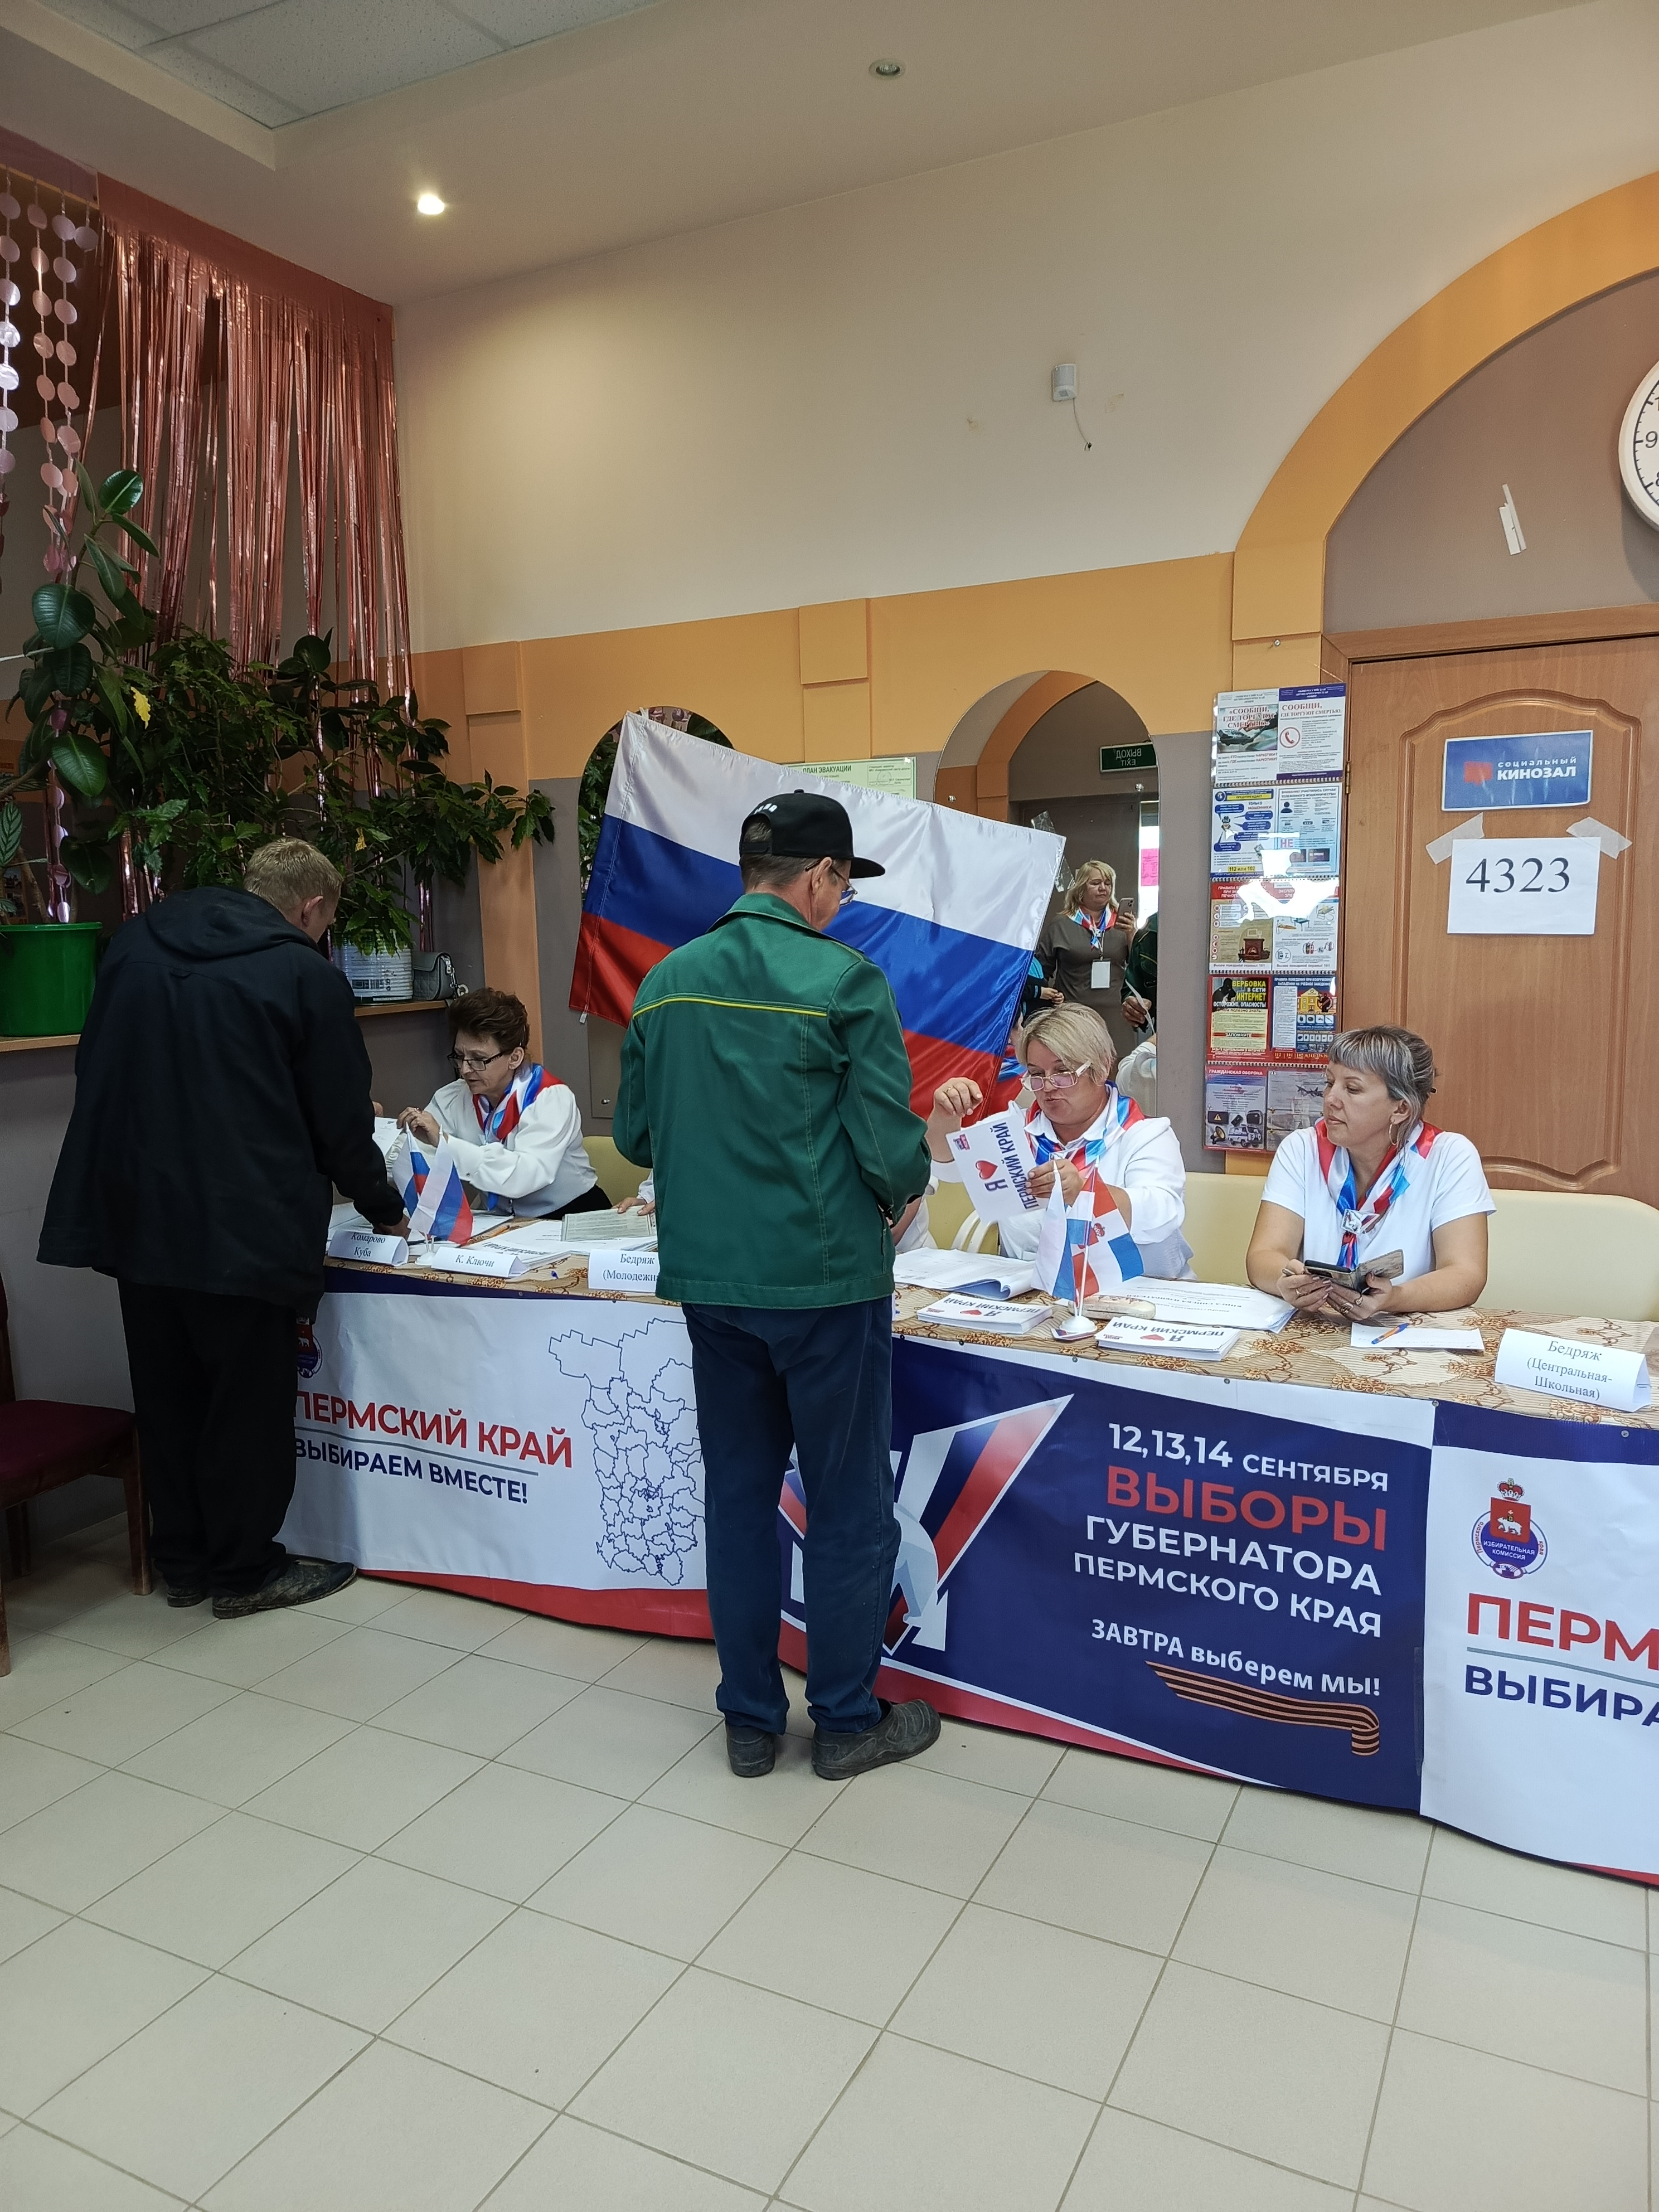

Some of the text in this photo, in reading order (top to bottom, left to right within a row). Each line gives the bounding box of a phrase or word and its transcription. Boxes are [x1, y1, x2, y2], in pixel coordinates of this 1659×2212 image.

[1646, 431, 1658, 448] 9
[1497, 756, 1577, 768] социальный
[1497, 766, 1577, 780] КИНОЗАЛ
[1280, 839, 1293, 848] НЕ
[1465, 857, 1570, 892] 4323
[1236, 993, 1266, 1001] ИНТЕРНЕТ
[989, 1122, 1039, 1210] ПЕРМСКИЙ КРАЙ
[984, 1178, 1008, 1192] Я
[351, 1232, 386, 1244] Комарово
[354, 1246, 371, 1258] Куба
[455, 1254, 495, 1267] К. Ключи
[620, 1253, 655, 1266] Бедряж
[943, 1297, 1041, 1313] ПЕРМСКИЙ КРАЙ
[1112, 1321, 1225, 1336] ПЕРМСКИЙ КРАЙ
[1548, 1341, 1602, 1361] Бедряж
[1527, 1357, 1613, 1382] (Центральная-
[1535, 1375, 1600, 1400] Школьная)
[297, 1391, 572, 1468] ПЕРМСКИЙ КРАЙ
[1109, 1423, 1388, 1492] 12,13,14 СЕНТЯБРЯ
[295, 1438, 528, 1504] ВЫБИРАЕМ ВМЕСТЕ!
[1106, 1465, 1386, 1551] ВЫБОРЫ
[1475, 1521, 1483, 1554] Пермского
[1086, 1515, 1381, 1595] ГУБЕРНАТОРА
[1483, 1540, 1535, 1555] ИЗБИРАТЕЛЬНАЯ
[1492, 1549, 1526, 1560] КОМИССИЯ
[1074, 1552, 1381, 1637] ПЕРМСКОГО КРАЯ
[1467, 1593, 1659, 1671] ПЕРМ
[1092, 1619, 1380, 1696] ЗАВТРА выберем МЫ!
